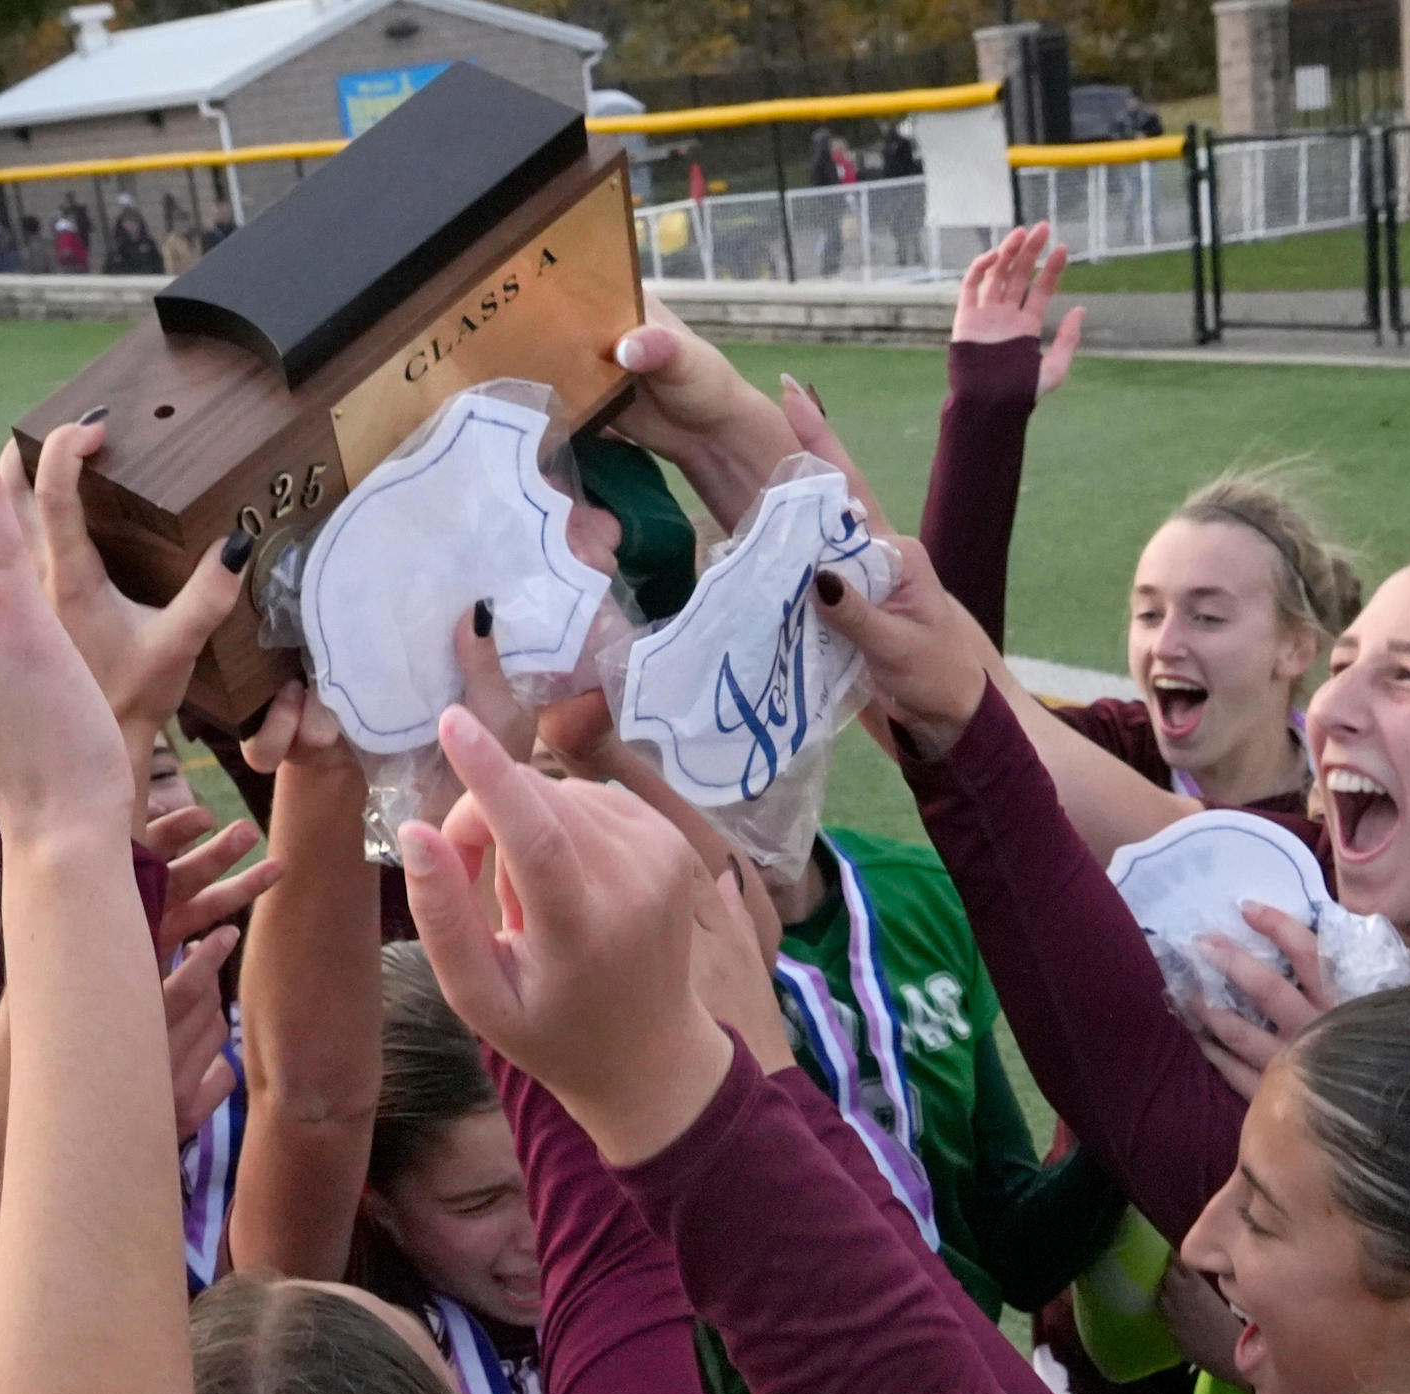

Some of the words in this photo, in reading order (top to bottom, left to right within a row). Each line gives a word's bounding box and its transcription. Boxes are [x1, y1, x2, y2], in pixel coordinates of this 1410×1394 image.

[404, 273, 521, 384] CLASS
[535, 247, 558, 278] A
[241, 461, 328, 540] 025
